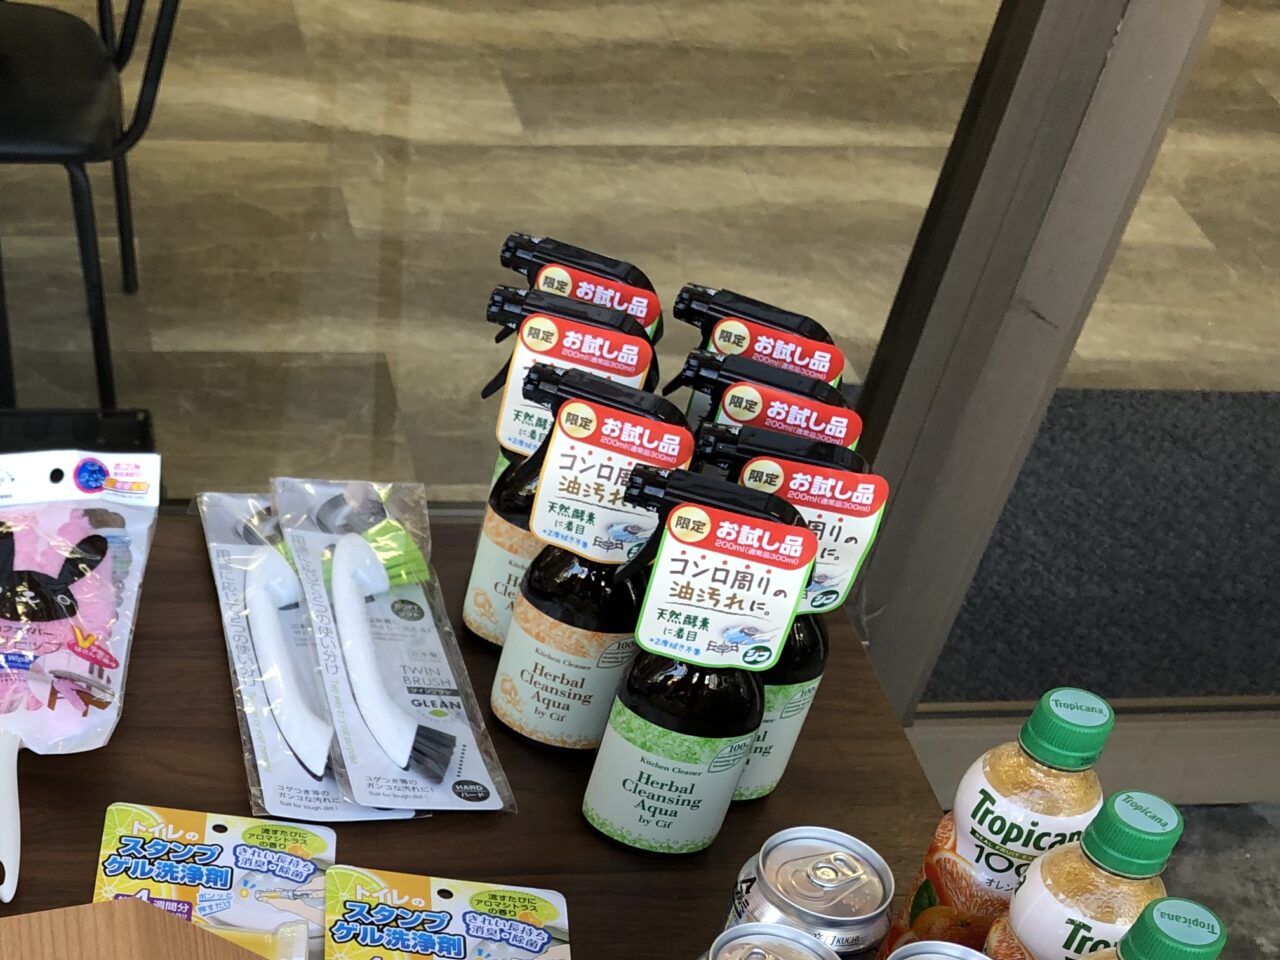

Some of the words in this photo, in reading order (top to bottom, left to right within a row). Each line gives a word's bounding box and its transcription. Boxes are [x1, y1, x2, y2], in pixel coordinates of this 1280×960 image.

[542, 276, 569, 294] 限定
[576, 281, 648, 318] お試し品
[526, 326, 555, 344] 限定
[718, 330, 746, 348] 限定
[562, 330, 639, 366] お試し品
[754, 335, 831, 372] お試し品
[728, 395, 758, 413] 限定
[565, 412, 593, 431] 限定
[767, 401, 848, 438] お試し品
[601, 417, 680, 456] お試し品
[748, 469, 780, 487] 限定
[789, 472, 875, 504] お試し品
[547, 501, 596, 526] 天然酵素
[675, 516, 706, 534] 限定
[555, 520, 585, 535] に着目
[716, 521, 804, 557] お試し品
[670, 558, 787, 598] コンロ周りの
[669, 581, 770, 616] 油汚れに。
[656, 608, 711, 631] 天然酵素
[663, 627, 698, 642] に着目
[400, 665, 441, 676] TWIN
[535, 648, 561, 664] Kitchen
[563, 656, 592, 671] Cleaner
[403, 676, 451, 687] BRUSH
[532, 662, 586, 689] Herbal
[520, 669, 594, 706] Cleansing
[531, 691, 570, 712] Aqua
[1051, 698, 1106, 717] Tropicana
[534, 706, 545, 719] by
[549, 709, 566, 722] Cif
[640, 755, 670, 772] Kitchen
[671, 766, 703, 777] Cleaner
[621, 777, 703, 811] Cleansing
[637, 770, 696, 795] Herbal
[461, 791, 485, 799] ハード
[633, 799, 678, 818] Aqua
[970, 788, 1083, 852] Tropican
[1121, 794, 1168, 830] Tropicana
[132, 820, 200, 841] トイレの
[261, 828, 308, 839] 流すたびに
[638, 815, 652, 826] by
[655, 819, 673, 829] Cif
[119, 837, 221, 863] スタンプ
[248, 833, 309, 846] アロマシトラス
[259, 842, 287, 850] の香り
[974, 832, 993, 848] REAL
[995, 844, 1019, 858] FRUIT
[237, 847, 314, 873] きれい長持ち
[238, 858, 307, 881] 消臭・除菌
[104, 855, 232, 889] ゲル洗浄剤
[356, 884, 426, 907] トイレの
[475, 899, 539, 912] アロマシトラス
[488, 893, 536, 905] 流すたびに
[345, 902, 450, 932] スタンプ
[488, 908, 517, 917] の香り
[1160, 909, 1218, 936] Tropicana
[333, 922, 466, 957] ゲル洗浄剤
[467, 914, 548, 942] きれい長持ち
[471, 926, 541, 951] 消臭・除菌
